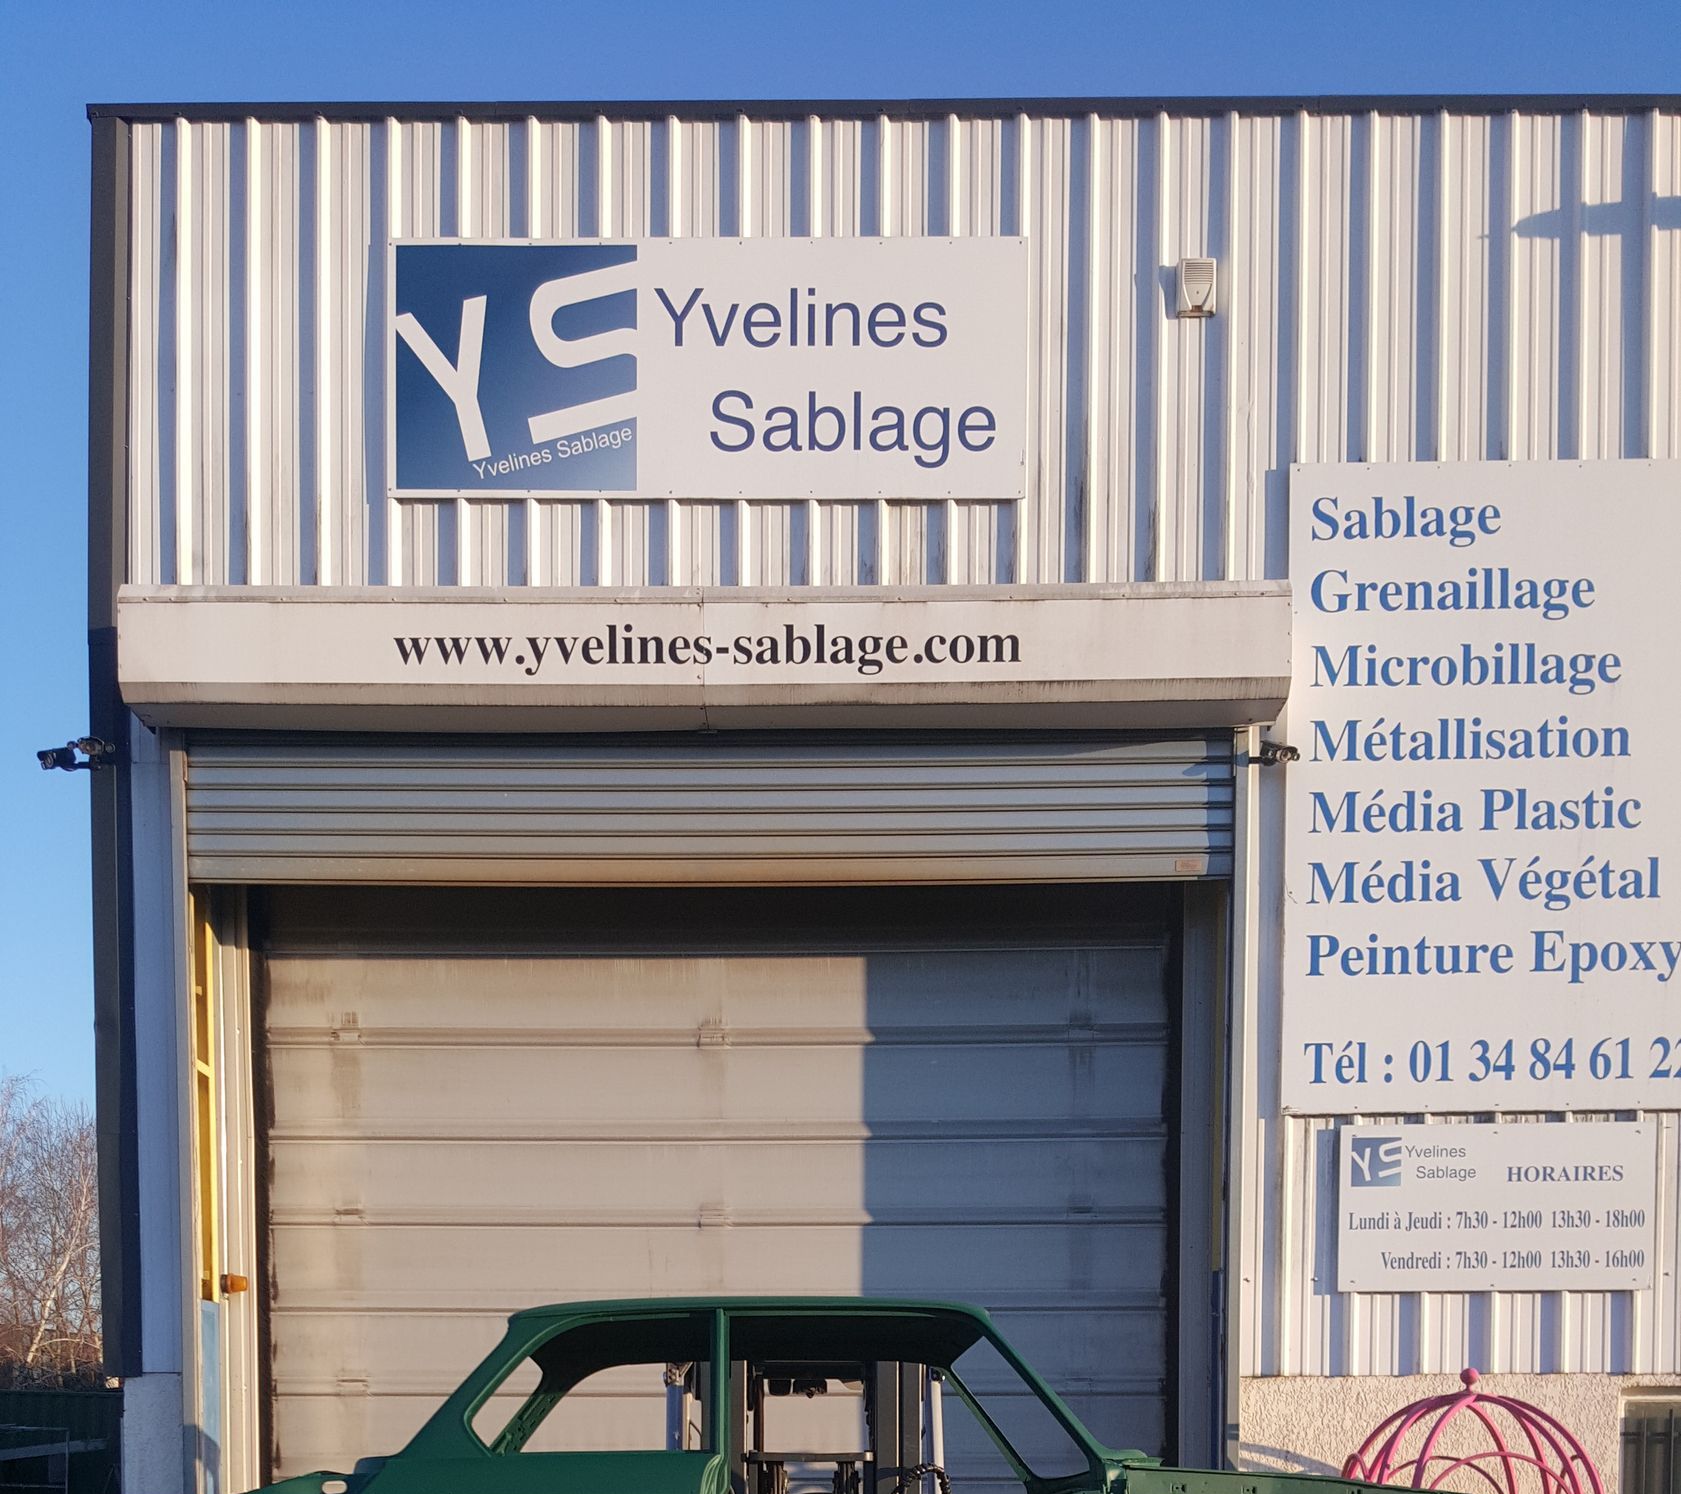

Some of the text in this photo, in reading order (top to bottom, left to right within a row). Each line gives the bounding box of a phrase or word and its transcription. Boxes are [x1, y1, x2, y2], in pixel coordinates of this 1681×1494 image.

[654, 288, 947, 347] Yvelines
[473, 428, 632, 479] Yvelines Sablage
[710, 390, 995, 468] Sablage
[1312, 496, 1501, 547] Sablage
[1311, 568, 1595, 620] Grenaillage
[393, 623, 1022, 675] www.yvelines-sablage.com
[1311, 643, 1621, 695] Microbillage
[1309, 716, 1631, 761] Métallisation
[1308, 786, 1641, 833] Média Plastic
[1306, 855, 1660, 911] Média Végétal
[1306, 931, 1681, 983] Peinture Epoxy
[1304, 1041, 1367, 1084] Tél
[1410, 1040, 1453, 1082] 01
[1469, 1039, 1515, 1081] 34
[1530, 1038, 1575, 1080] 84
[1590, 1037, 1633, 1080] 61
[1404, 1145, 1467, 1159] Yvelines
[1415, 1165, 1477, 1182] Sablage
[1506, 1165, 1625, 1183] HORAIRES
[1348, 1211, 1390, 1231] Lundi
[1393, 1211, 1402, 1230] à
[1405, 1211, 1442, 1232] Jeudi
[1455, 1210, 1489, 1229] 7h30
[1503, 1210, 1543, 1229] 12h00
[1552, 1209, 1592, 1229] 13h30
[1606, 1209, 1646, 1228] 18h00
[1380, 1251, 1442, 1270] Vendredi
[1455, 1250, 1488, 1269] 7h30
[1502, 1250, 1542, 1269] 12h00
[1551, 1249, 1591, 1269] 13h30
[1605, 1249, 1645, 1268] 16h00
